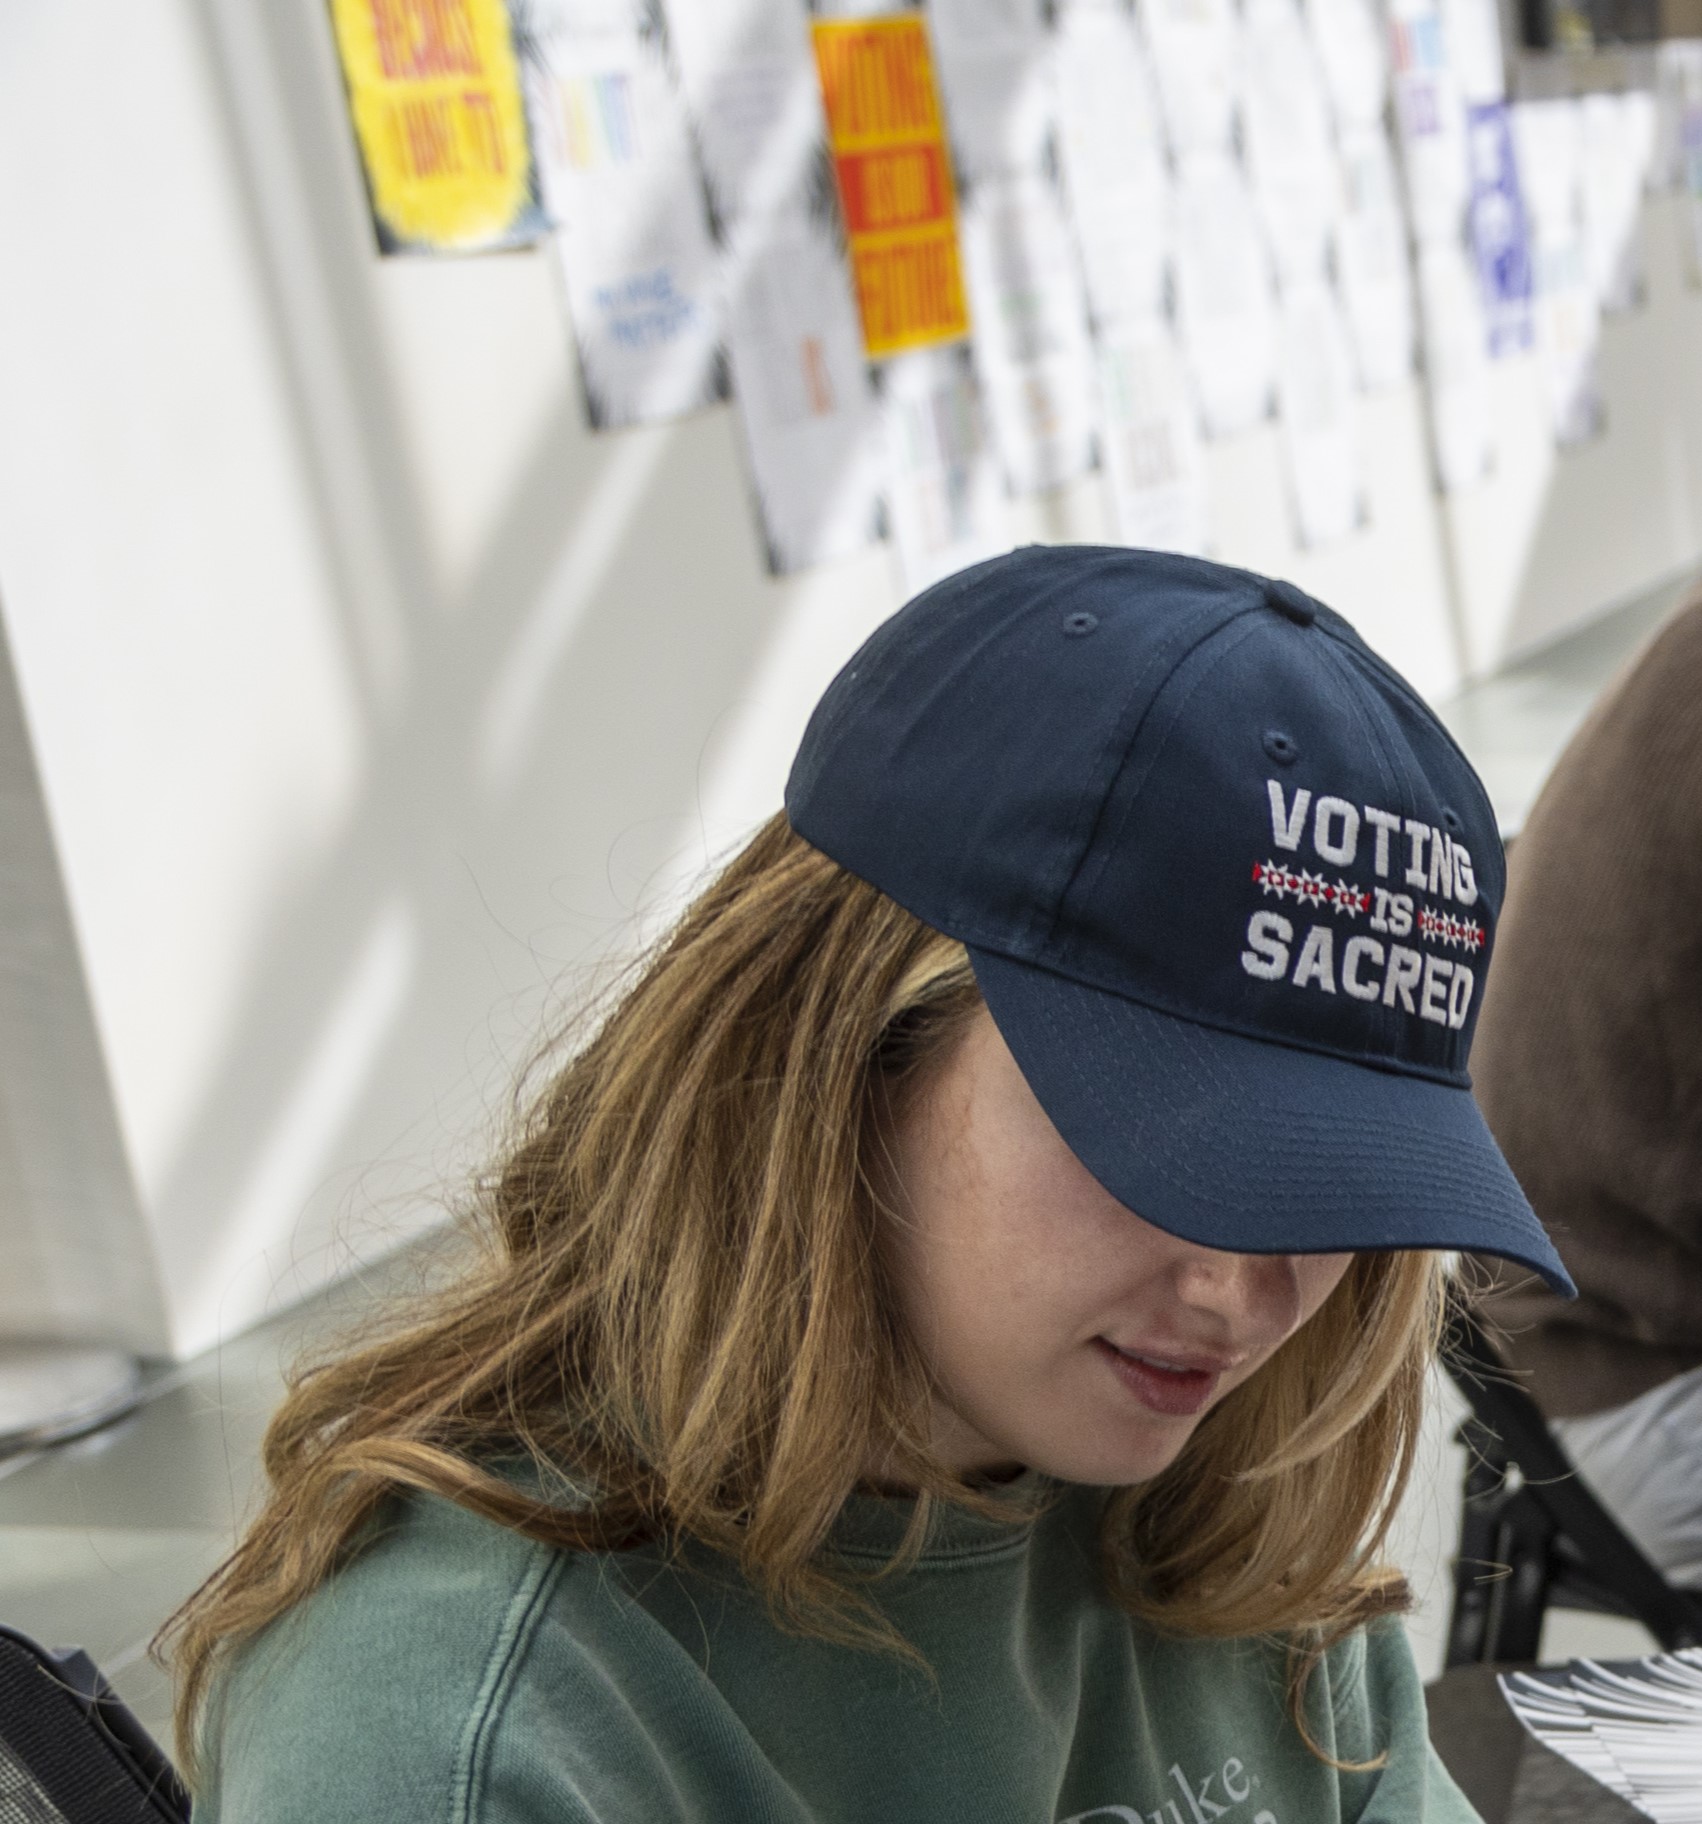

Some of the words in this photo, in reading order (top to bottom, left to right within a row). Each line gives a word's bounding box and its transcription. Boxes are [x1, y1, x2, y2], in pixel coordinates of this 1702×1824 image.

[1267, 778, 1478, 906] VOTING
[1242, 910, 1474, 1030] SACRED
[1370, 886, 1414, 937] IS
